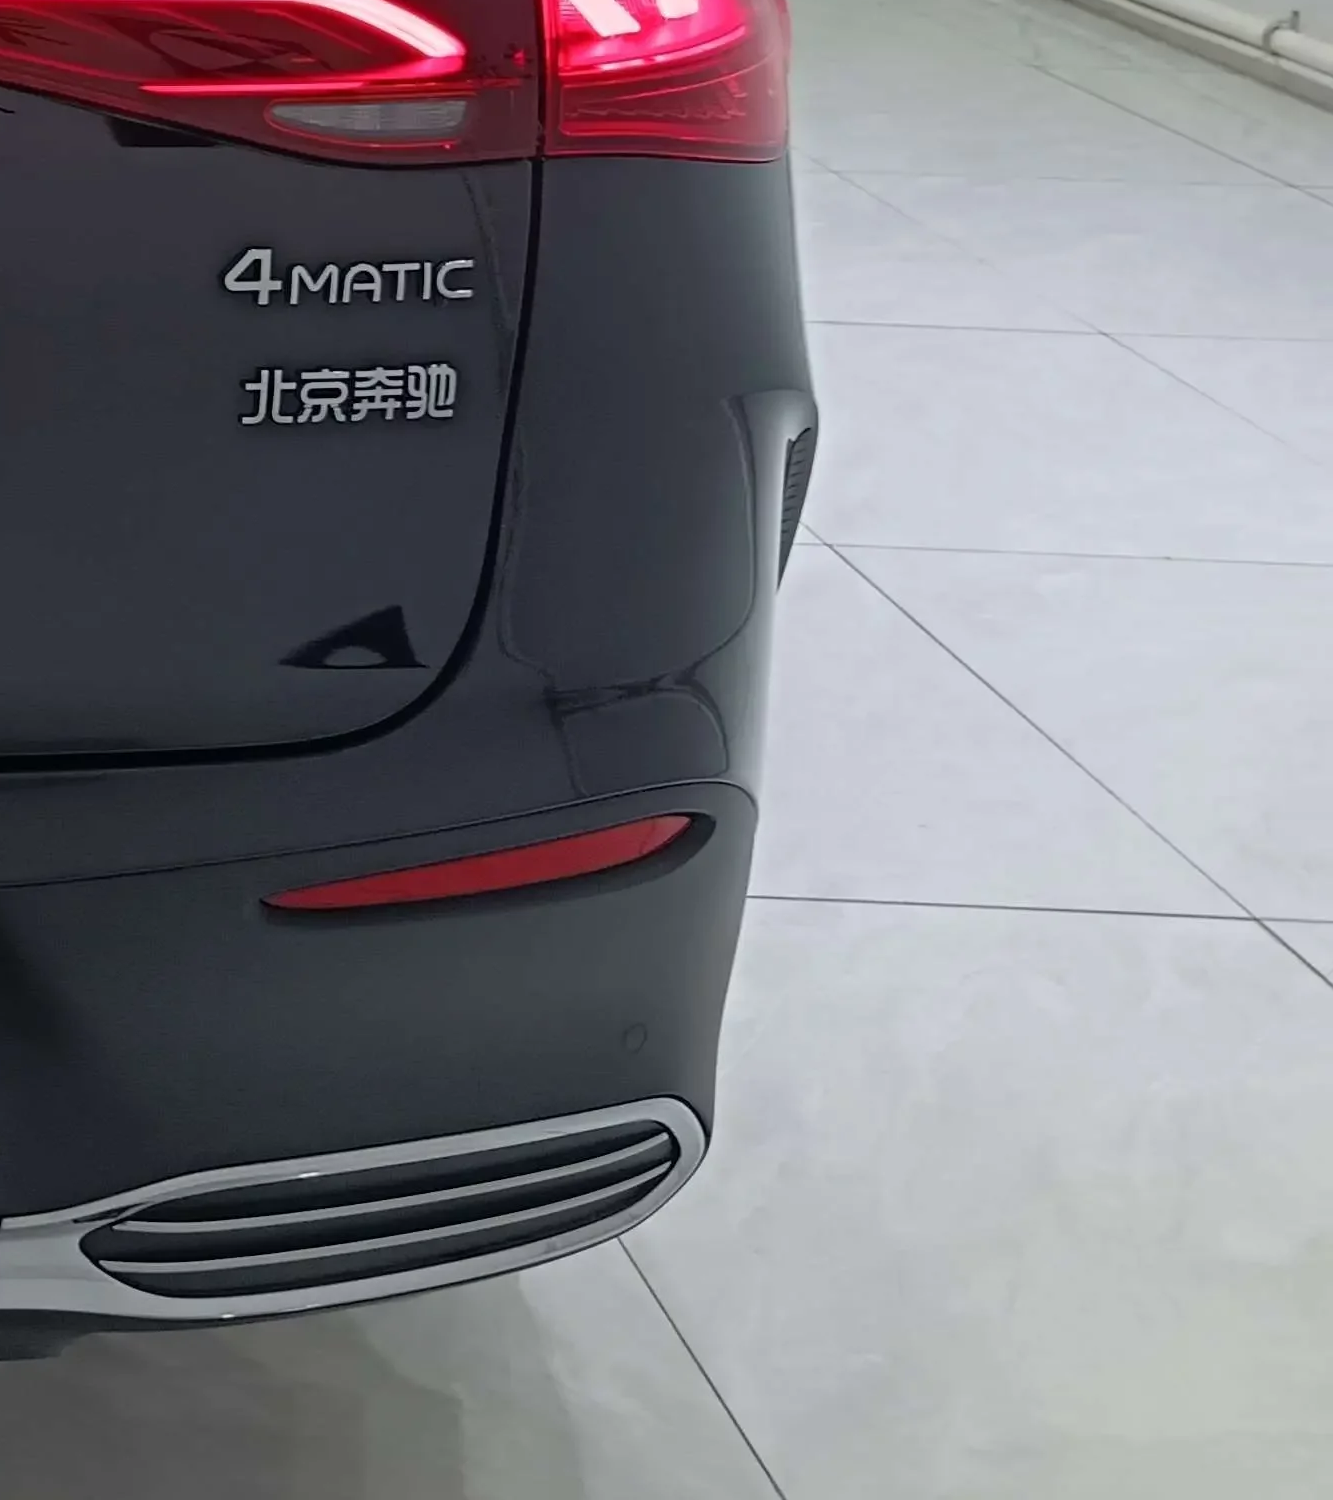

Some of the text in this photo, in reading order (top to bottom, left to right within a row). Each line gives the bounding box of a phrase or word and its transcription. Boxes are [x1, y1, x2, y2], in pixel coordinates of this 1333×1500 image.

[224, 248, 475, 306] 4MATIC
[241, 363, 457, 425] 北京奔驰
